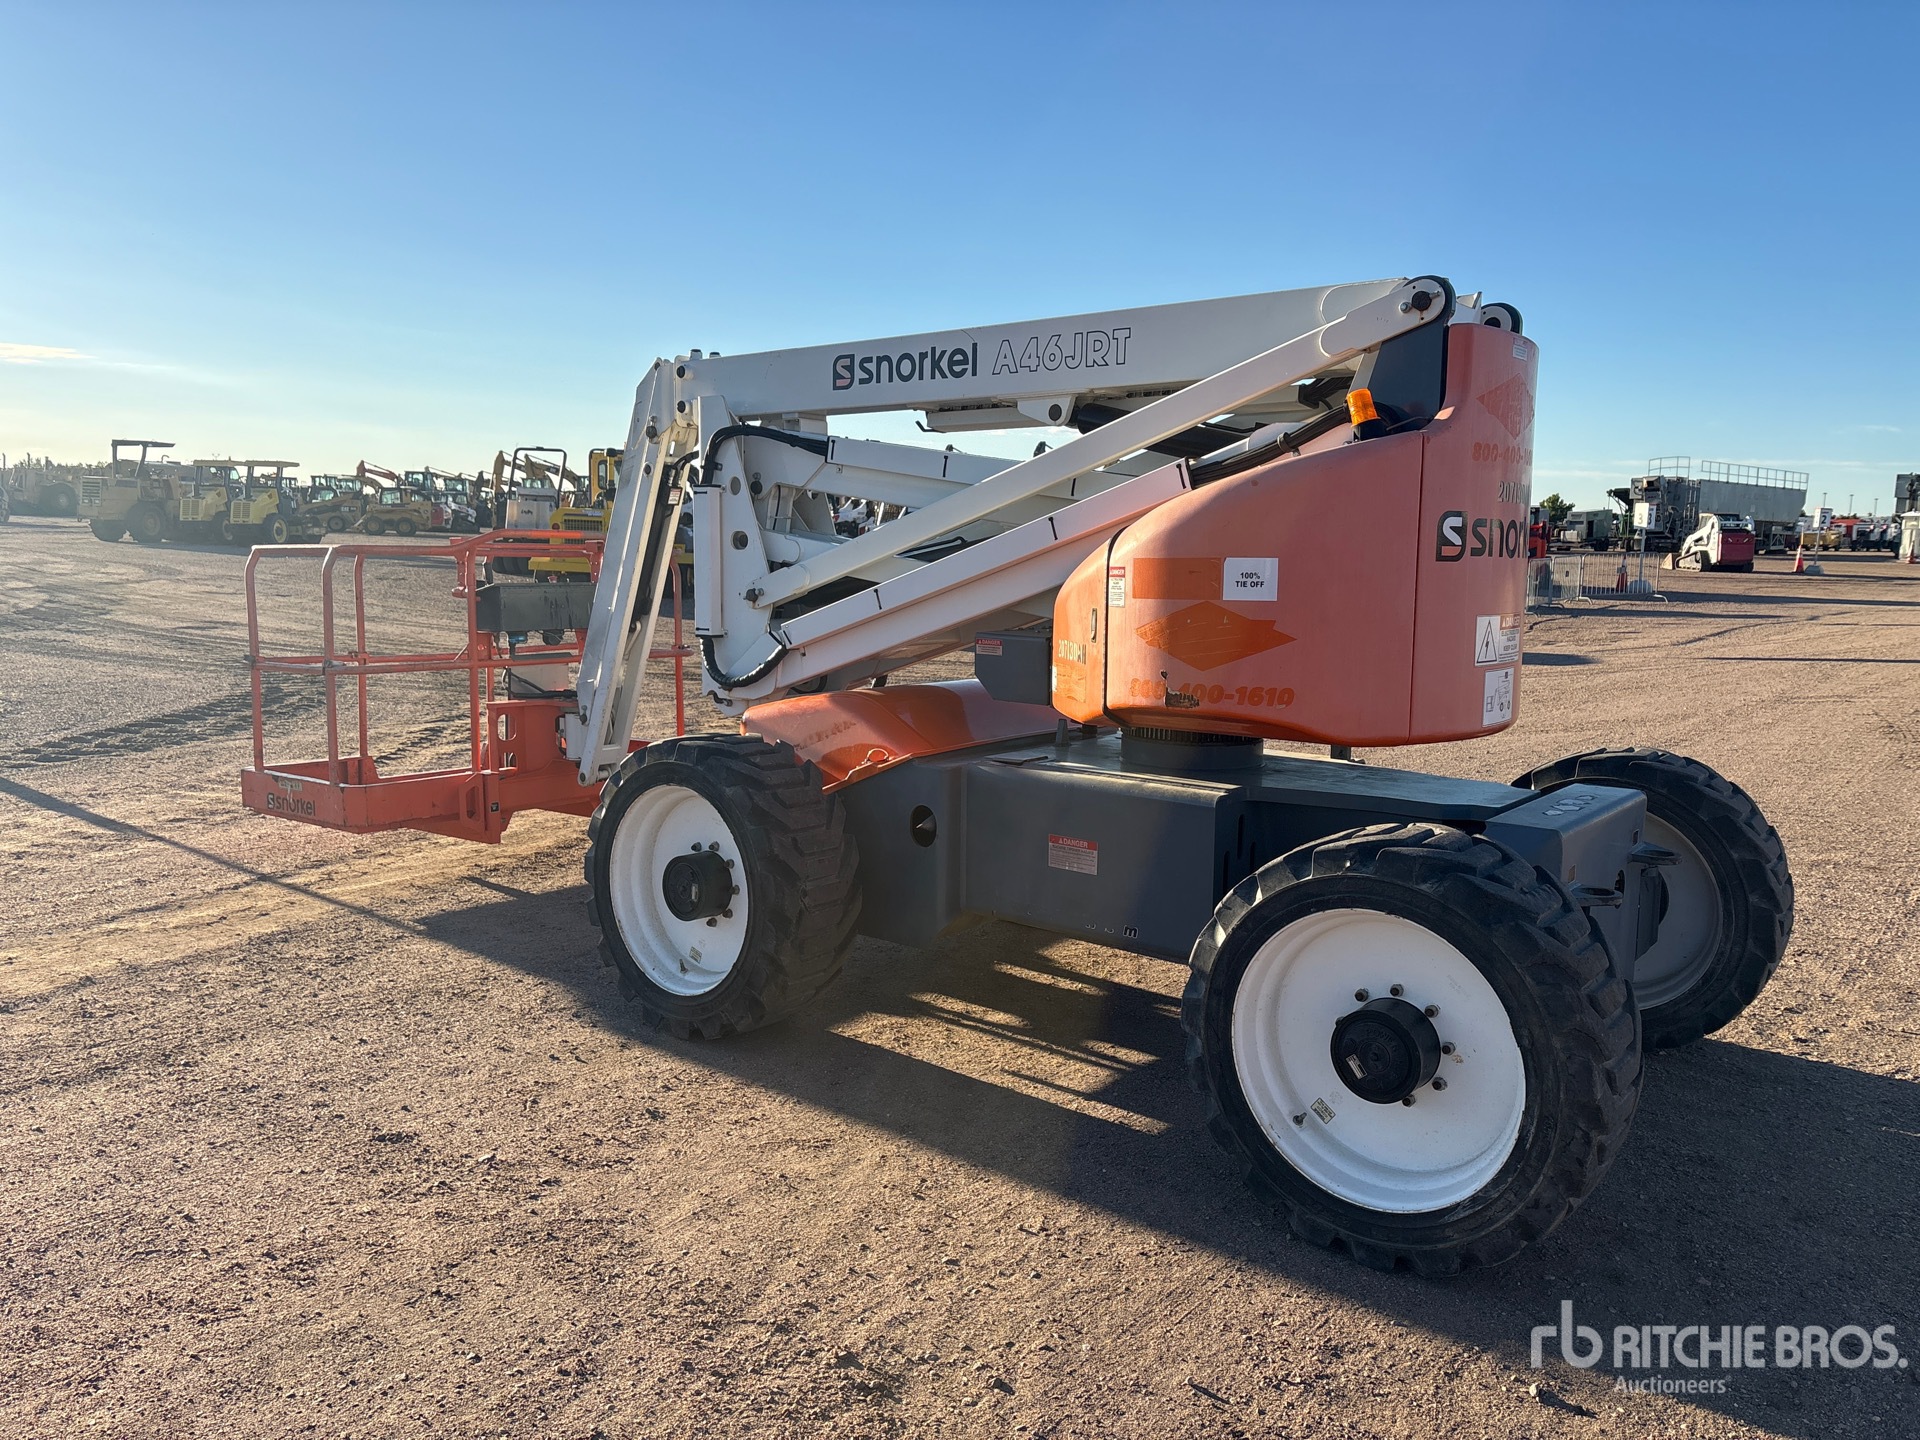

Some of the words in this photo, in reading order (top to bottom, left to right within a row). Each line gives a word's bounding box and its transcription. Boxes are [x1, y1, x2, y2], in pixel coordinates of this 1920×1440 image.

[858, 341, 978, 385] snorkel
[991, 327, 1132, 375] A46JRT
[1637, 513, 1644, 525] 3
[1821, 515, 1827, 524] 2
[1239, 572, 1261, 580] 100%
[1234, 580, 1249, 588] TIE
[1249, 580, 1266, 588] OFF
[1130, 677, 1296, 708] 800400-1610
[275, 796, 316, 816] snorkel
[1063, 838, 1089, 848] DANGER
